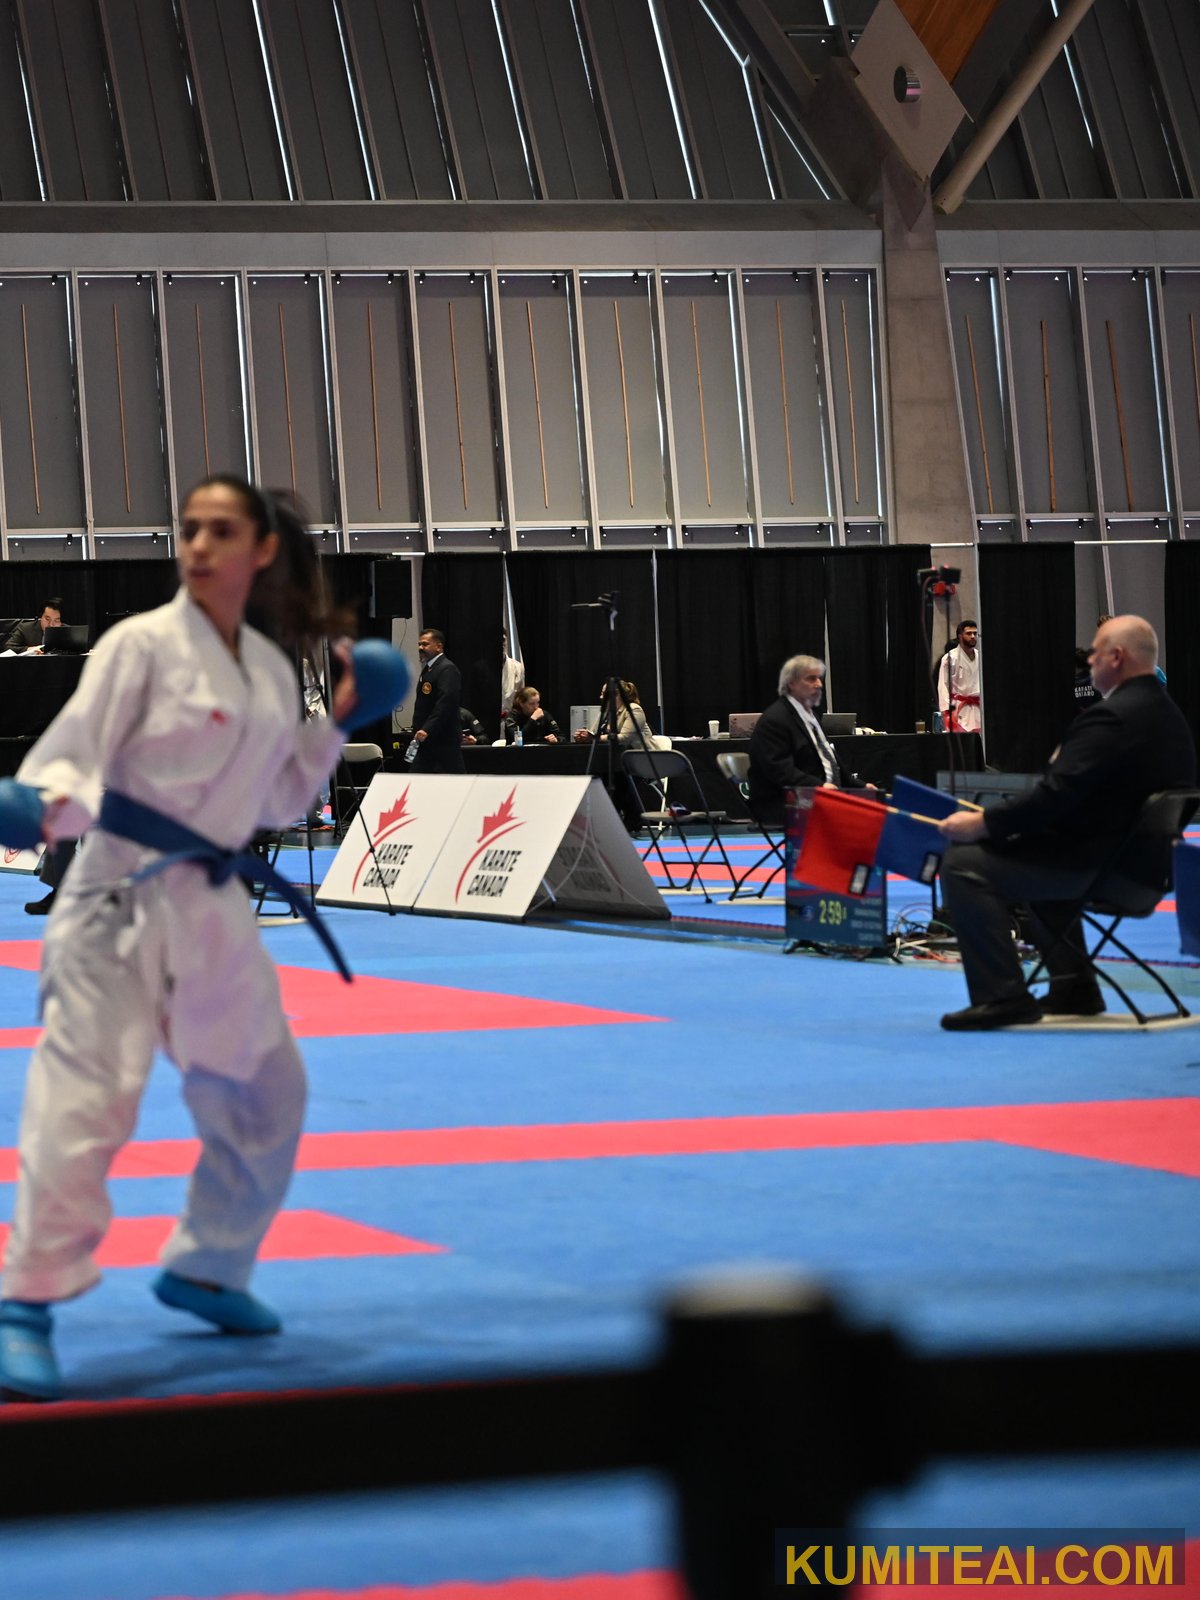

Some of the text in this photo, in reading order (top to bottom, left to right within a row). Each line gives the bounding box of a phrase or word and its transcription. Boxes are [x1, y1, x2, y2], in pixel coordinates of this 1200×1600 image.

[376, 843, 413, 865] KARATE
[478, 849, 522, 872] KARATE
[363, 867, 401, 888] CANADA
[466, 874, 509, 897] CANADA
